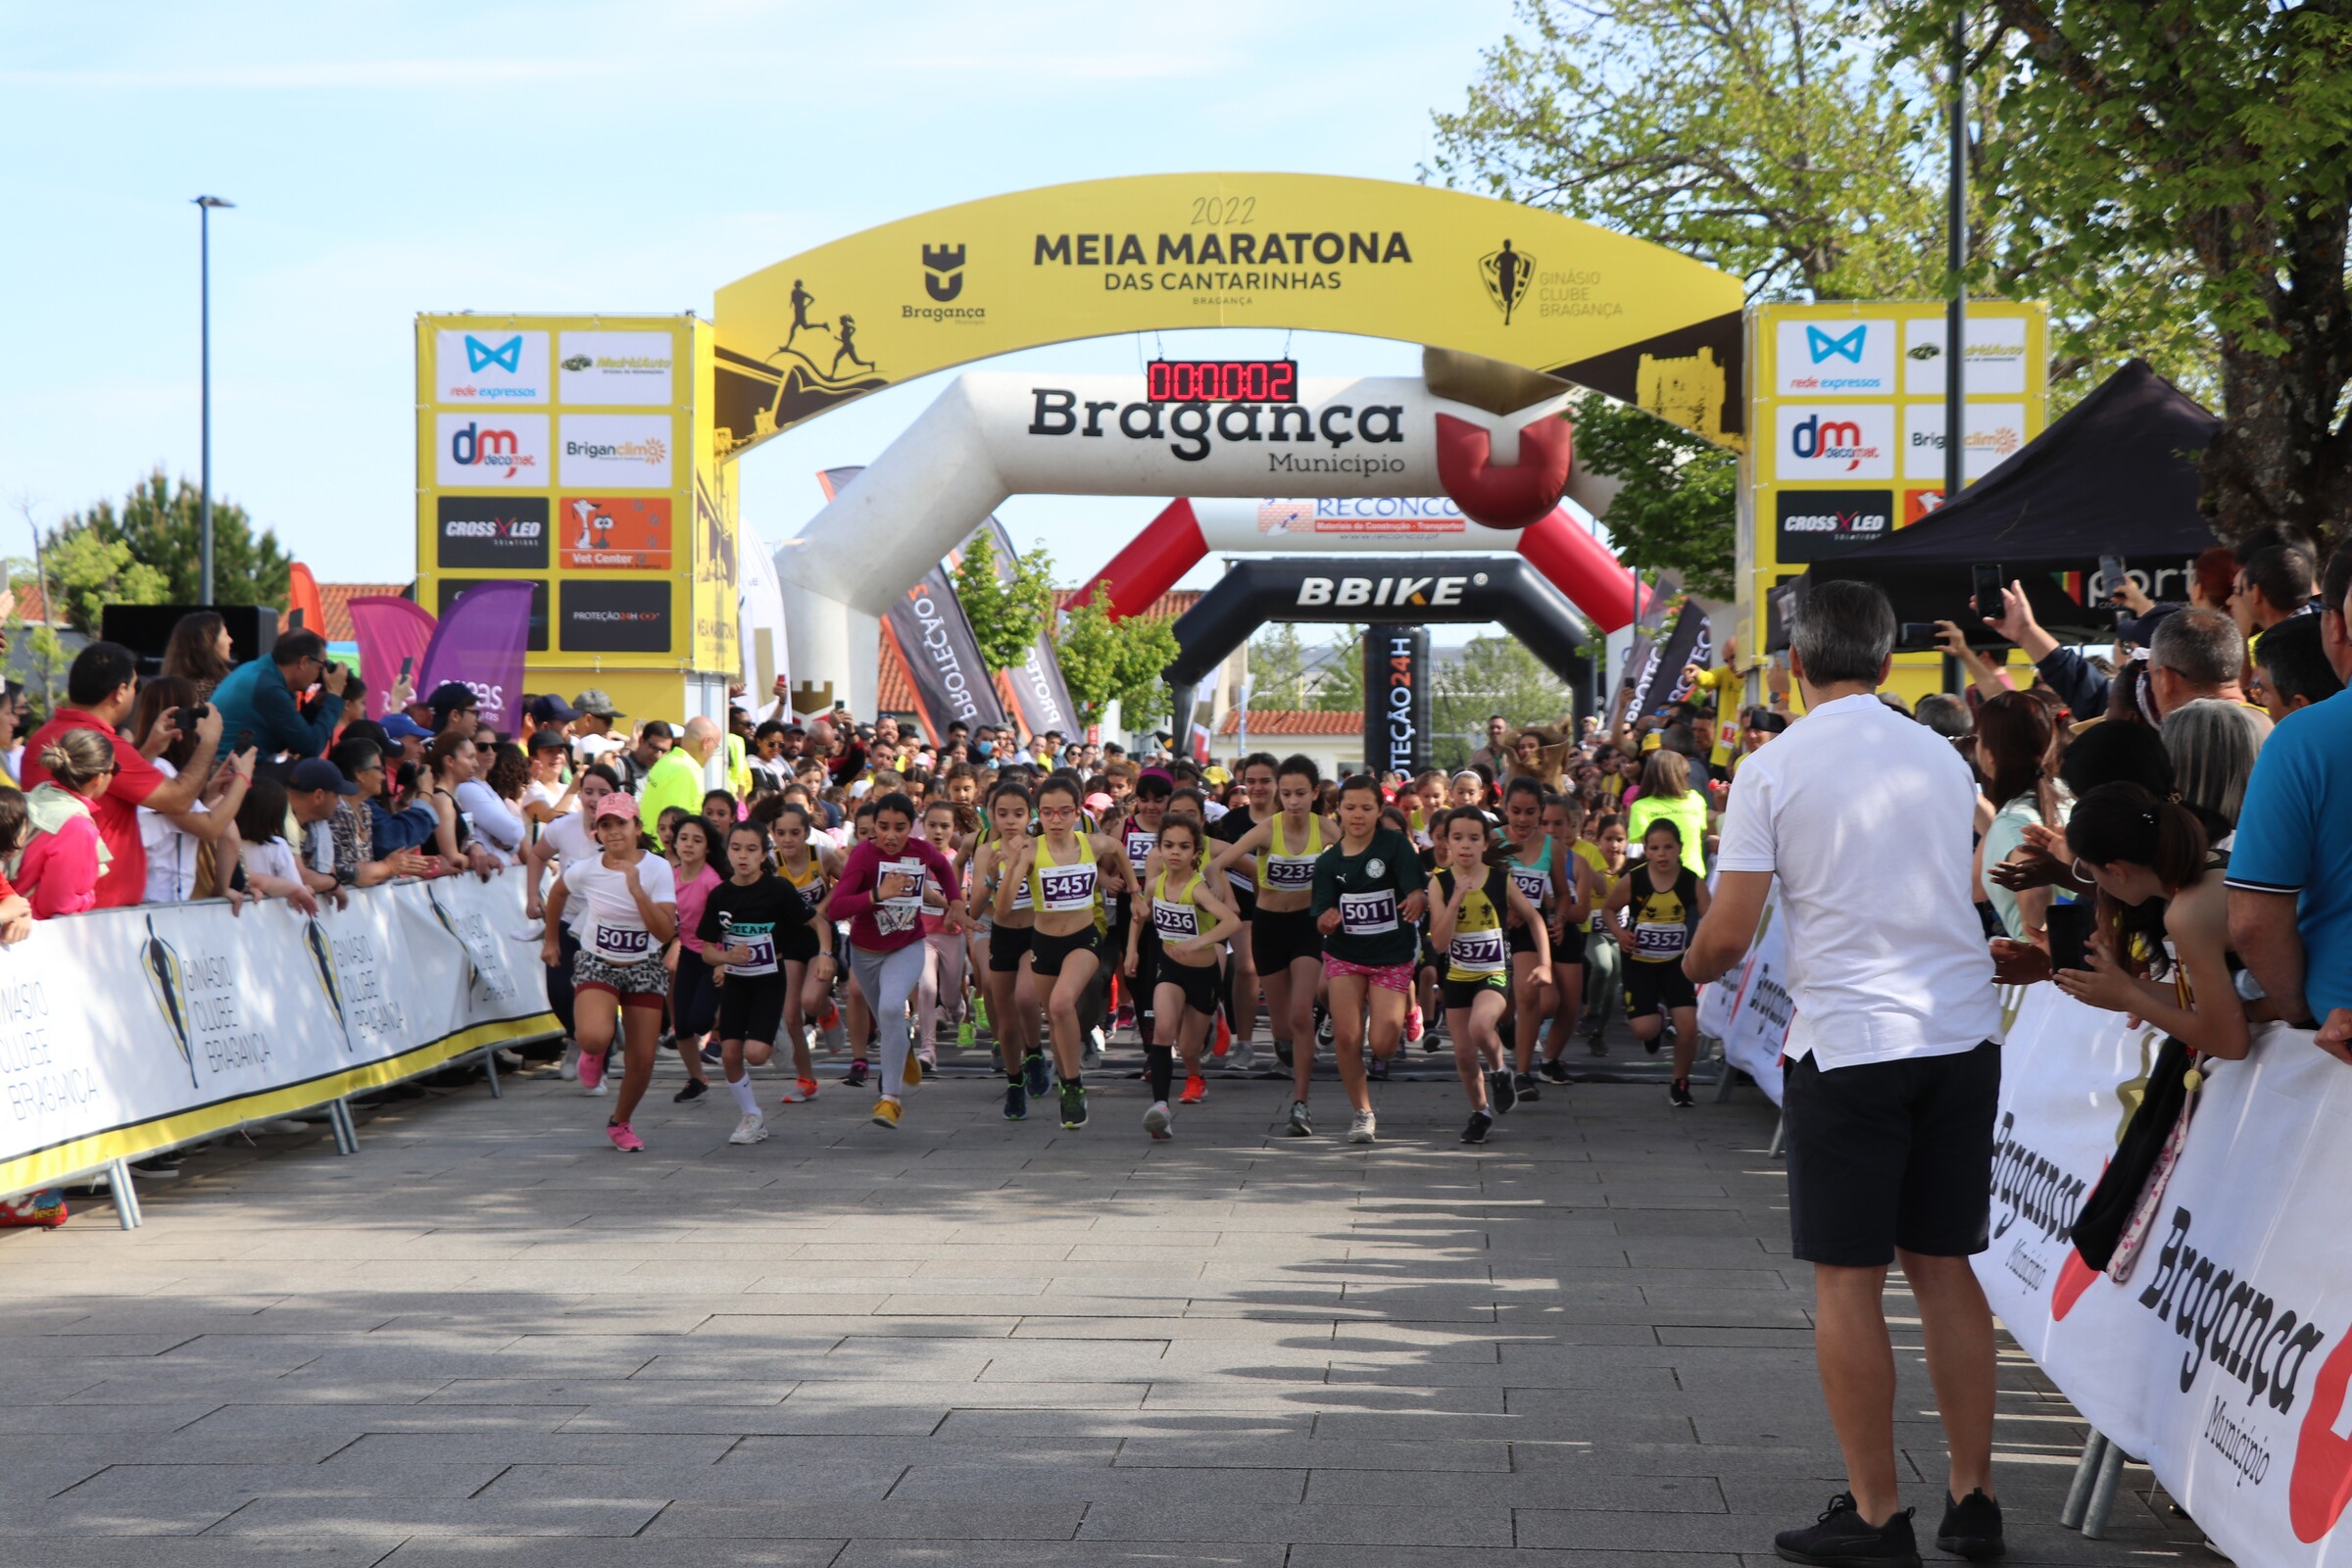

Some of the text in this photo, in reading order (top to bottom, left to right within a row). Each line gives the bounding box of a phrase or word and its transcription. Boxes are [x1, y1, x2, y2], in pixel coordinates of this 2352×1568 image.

[1190, 196, 1255, 225] 2022
[1034, 231, 1412, 266] MEIA MARATONA
[1104, 270, 1343, 291] DAS CANTARINHAS
[1539, 268, 1601, 285] GINÁSIO
[1192, 296, 1254, 306] BRAGANÇA
[1539, 286, 1590, 301] CLUBE
[901, 305, 986, 322] Bragança
[1539, 302, 1624, 319] BRAGANÇA
[450, 385, 536, 399] rede expressos
[1149, 363, 1293, 401] 00:00:02
[1790, 377, 1882, 390] rede expressos
[1028, 388, 1403, 462] Bragança
[1268, 453, 1405, 477] Município
[1316, 497, 1461, 516] RECONCO
[1316, 521, 1352, 530] Materiais
[1354, 521, 1364, 530] de
[1366, 521, 1411, 532] Construção
[1417, 521, 1465, 532] Transportes
[572, 553, 633, 564] Vet Center
[1296, 576, 1468, 606] BBIKE
[1387, 638, 1416, 782] OTEÇÃO24H
[1131, 841, 1153, 856] 52
[1270, 864, 1315, 879] 5235
[802, 886, 822, 903] 37
[1046, 874, 1092, 896] 5451
[1514, 877, 1540, 894] 96
[1156, 908, 1194, 929] 5236
[1345, 900, 1390, 920] 5011
[598, 927, 647, 948] 5016
[733, 925, 769, 934] TEAM
[1639, 931, 1682, 947] 5352
[1451, 940, 1498, 958] 5377
[183, 950, 233, 992] GINÁSIO
[0, 975, 48, 1025] NÁSIO
[193, 996, 238, 1032] CLUBE
[0, 1028, 52, 1074] CLUBE
[205, 1032, 273, 1074] BRAGANÇA
[8, 1067, 100, 1121] BRAGANÇA
[1990, 1111, 2086, 1245] Bragança
[2137, 1205, 2326, 1415] Bragança
[2203, 1395, 2272, 1488] Município
